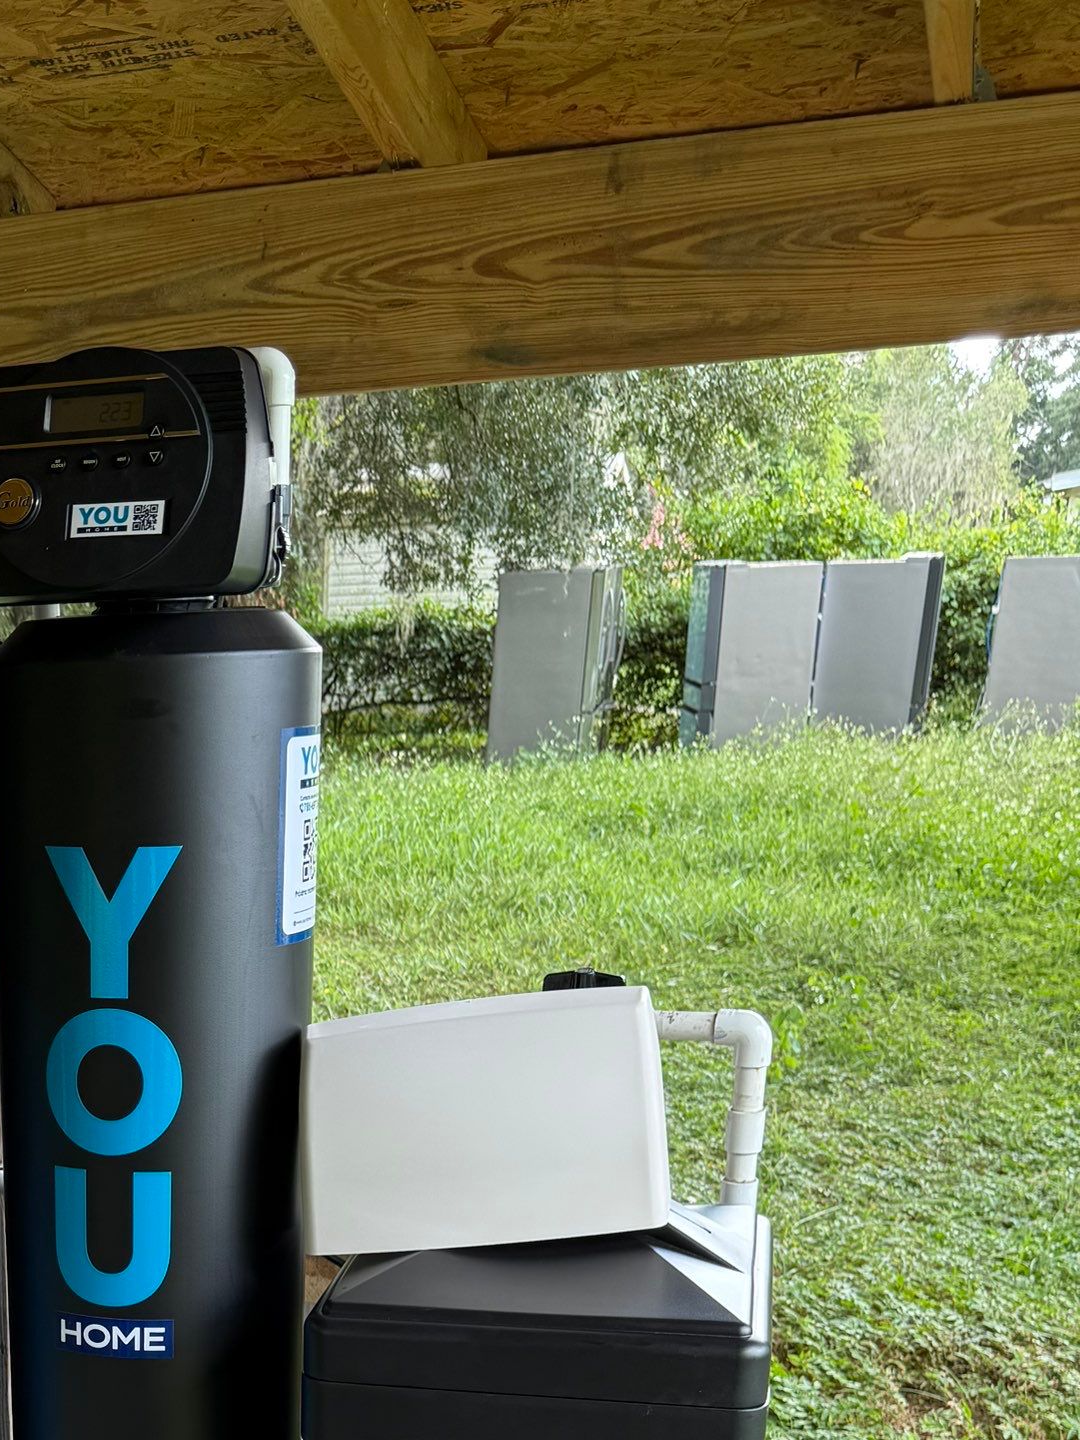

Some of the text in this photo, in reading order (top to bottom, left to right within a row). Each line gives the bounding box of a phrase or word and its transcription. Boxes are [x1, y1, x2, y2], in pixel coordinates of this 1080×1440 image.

[98, 400, 133, 424] 223
[79, 505, 130, 526] YOU
[301, 744, 318, 776] YO
[45, 845, 183, 1307] YOU
[59, 1317, 166, 1352] HOME
